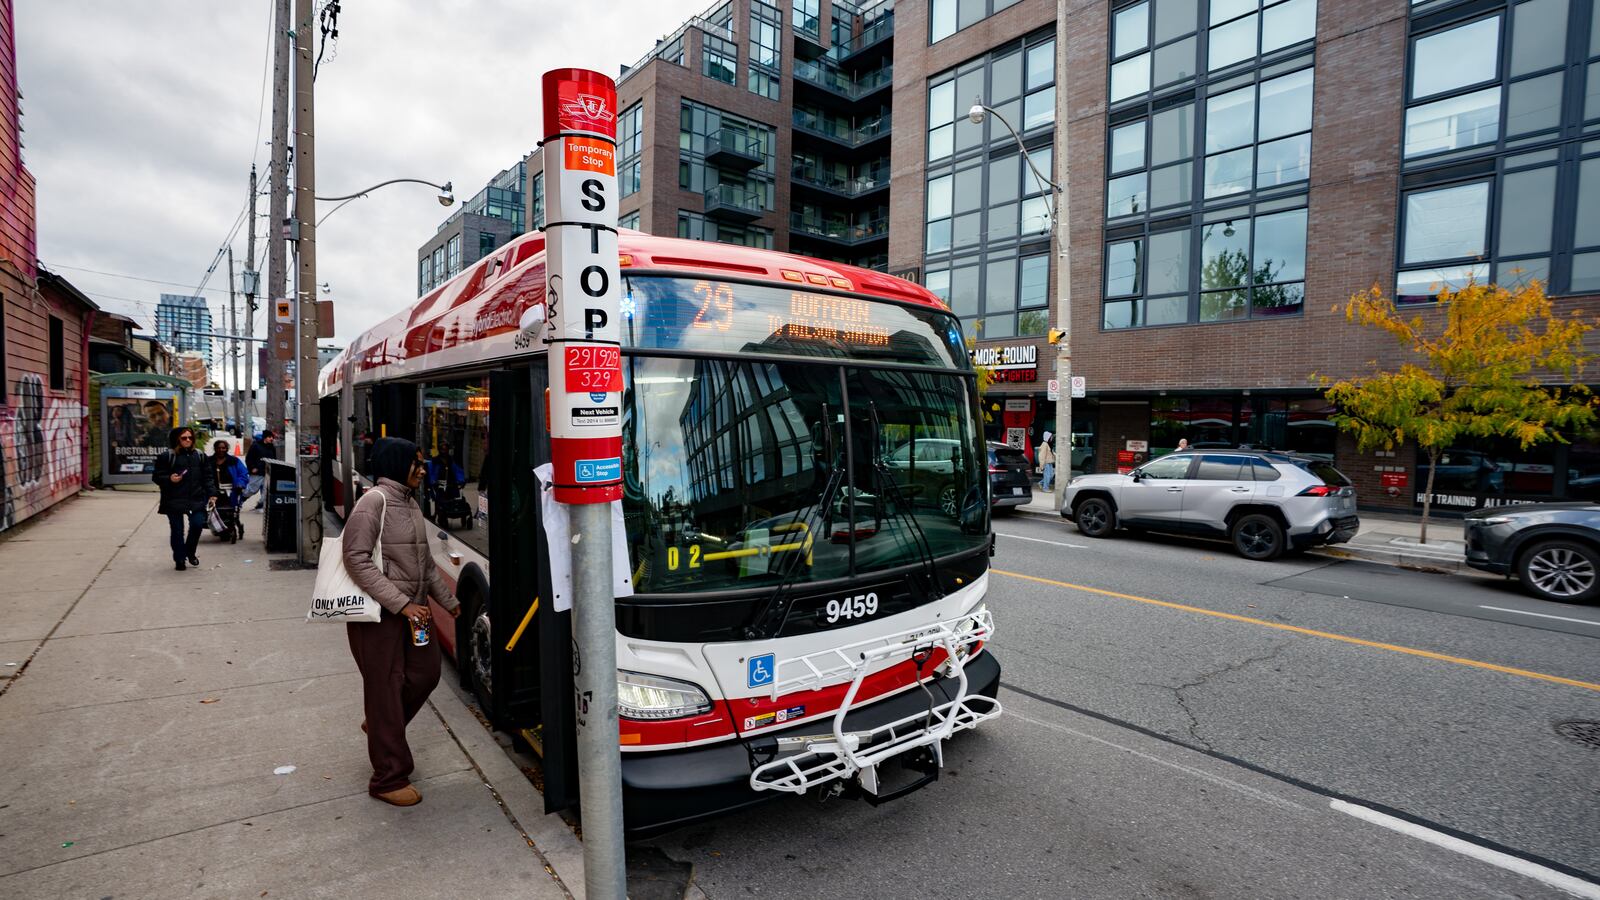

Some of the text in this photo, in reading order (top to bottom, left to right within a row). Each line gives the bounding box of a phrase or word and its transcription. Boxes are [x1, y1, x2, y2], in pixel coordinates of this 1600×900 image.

[567, 143, 613, 160] Temporary
[582, 155, 604, 168] Stop
[581, 178, 609, 339] STOP
[694, 280, 734, 330] 29
[790, 292, 870, 324] DUFFERIN
[767, 314, 784, 337] TO
[514, 334, 530, 349] 9459
[568, 348, 619, 368] 29 929
[975, 348, 1001, 365] MORE
[1002, 345, 1036, 364] ROUND
[580, 371, 612, 388] 329
[1003, 370, 1036, 382] FIGHTER
[579, 408, 615, 416] Next Vehicle
[115, 447, 147, 455] BOSTON
[1416, 492, 1434, 504] HIT
[1436, 494, 1477, 507] TRAINING
[315, 598, 335, 610] ONLY
[337, 595, 365, 608] WEAR
[825, 592, 879, 624] 9459
